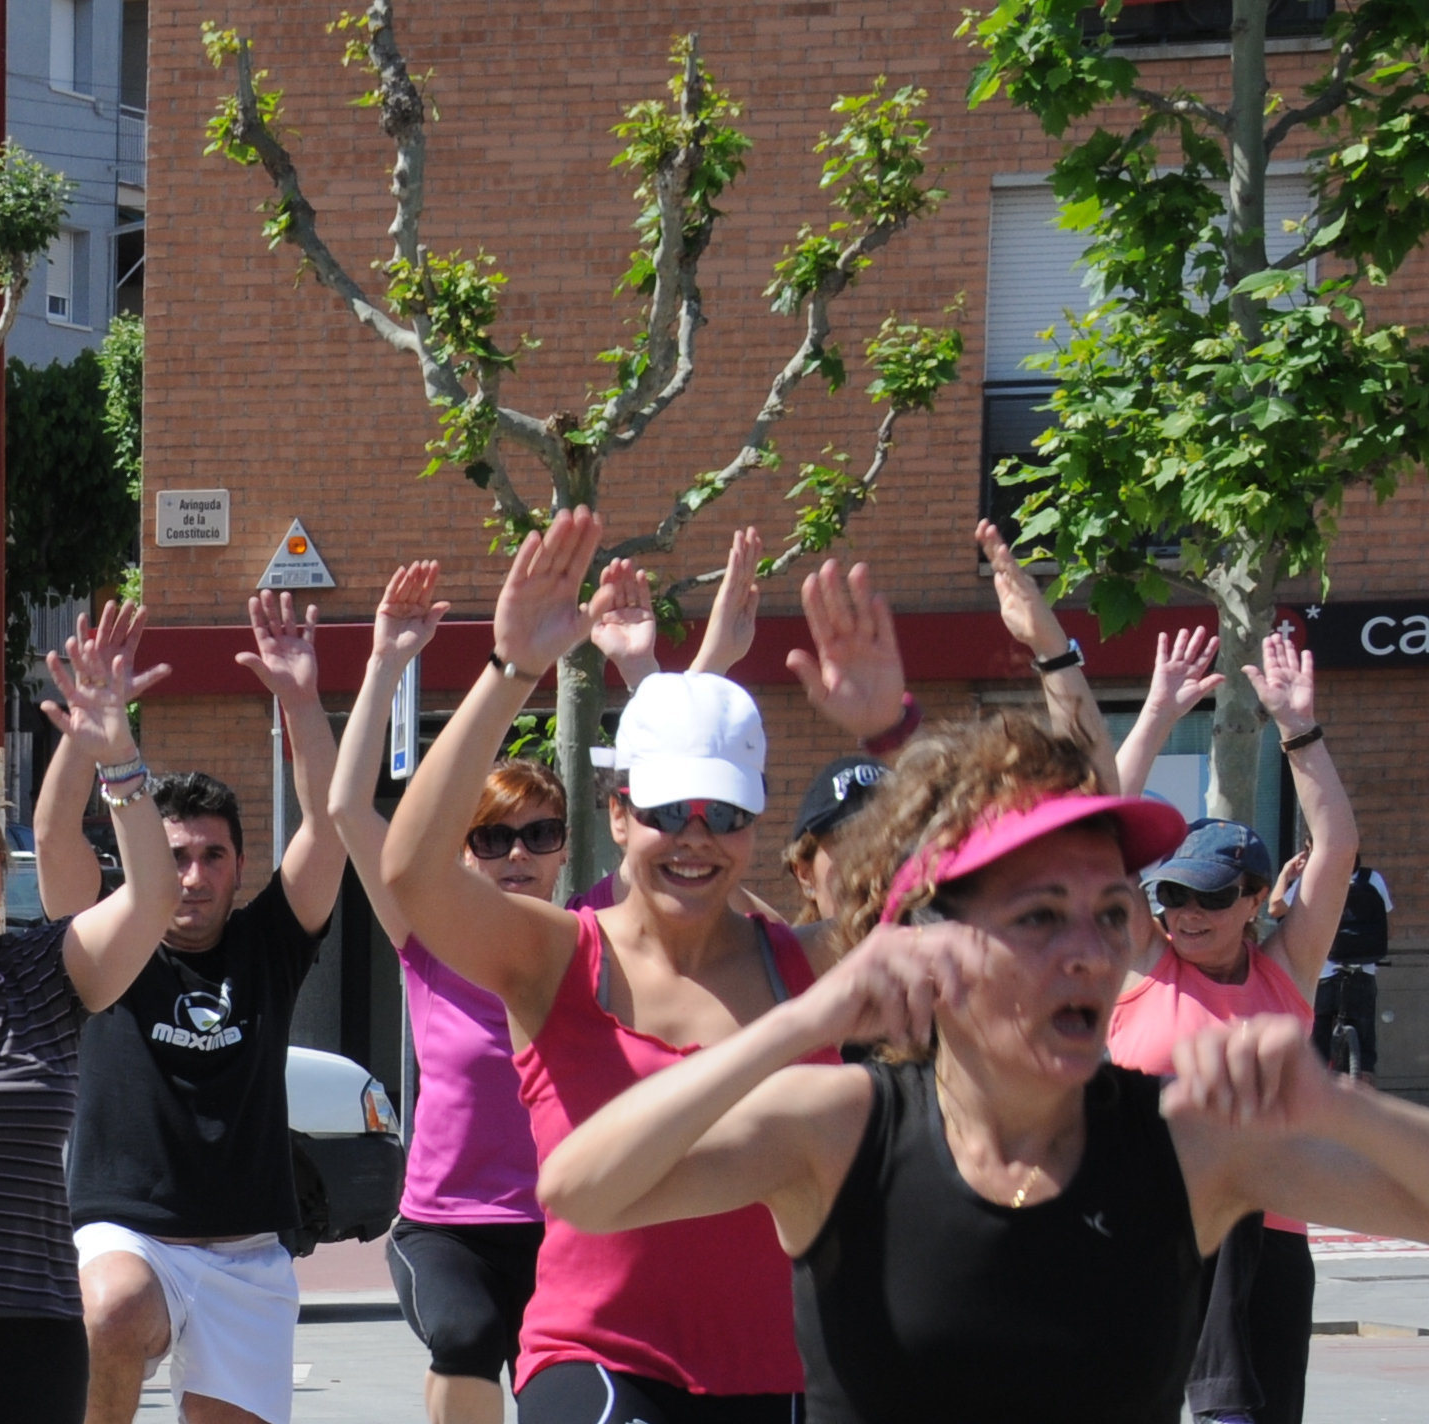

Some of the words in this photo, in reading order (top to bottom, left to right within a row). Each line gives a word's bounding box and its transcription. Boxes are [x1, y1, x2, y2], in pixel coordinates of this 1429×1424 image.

[179, 498, 222, 513] Avinguda
[183, 513, 195, 525] de
[197, 513, 206, 525] la
[166, 527, 220, 539] Constitució
